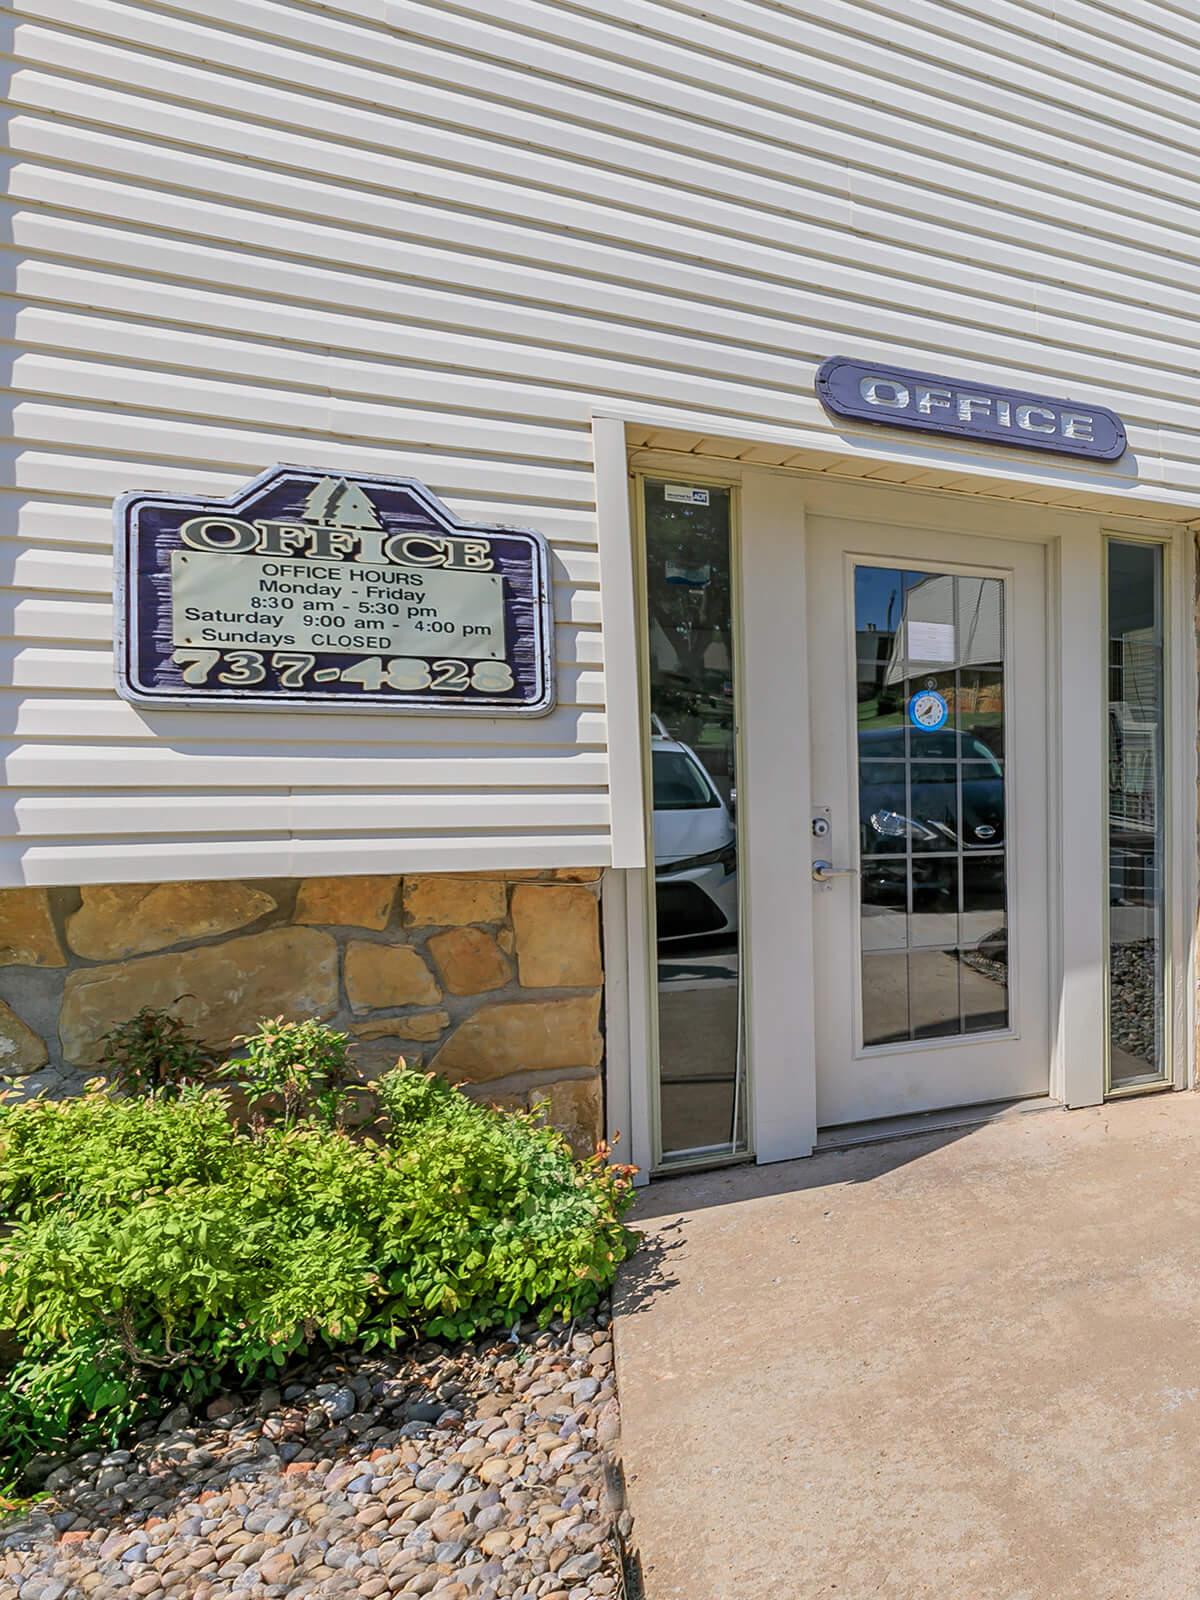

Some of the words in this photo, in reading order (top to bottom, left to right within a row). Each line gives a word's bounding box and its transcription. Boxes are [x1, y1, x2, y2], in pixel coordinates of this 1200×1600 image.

[859, 377, 1094, 442] OFFICE
[180, 517, 494, 571] OFFICE
[262, 563, 341, 581] OFFICE
[350, 570, 424, 586] HOURS
[260, 580, 341, 598] Monday
[366, 587, 426, 604] Friday
[185, 607, 284, 627] Saturday
[303, 615, 345, 628] 9:00
[354, 619, 385, 630] am
[414, 621, 455, 633] 4:00
[462, 623, 492, 637] pm
[251, 597, 294, 610] 8:30
[303, 601, 334, 612] am
[358, 602, 399, 615] 5:30
[407, 607, 437, 620] pm
[201, 628, 296, 647] Sundays
[311, 634, 392, 649] CLOSED
[172, 650, 515, 692] 737-4828
